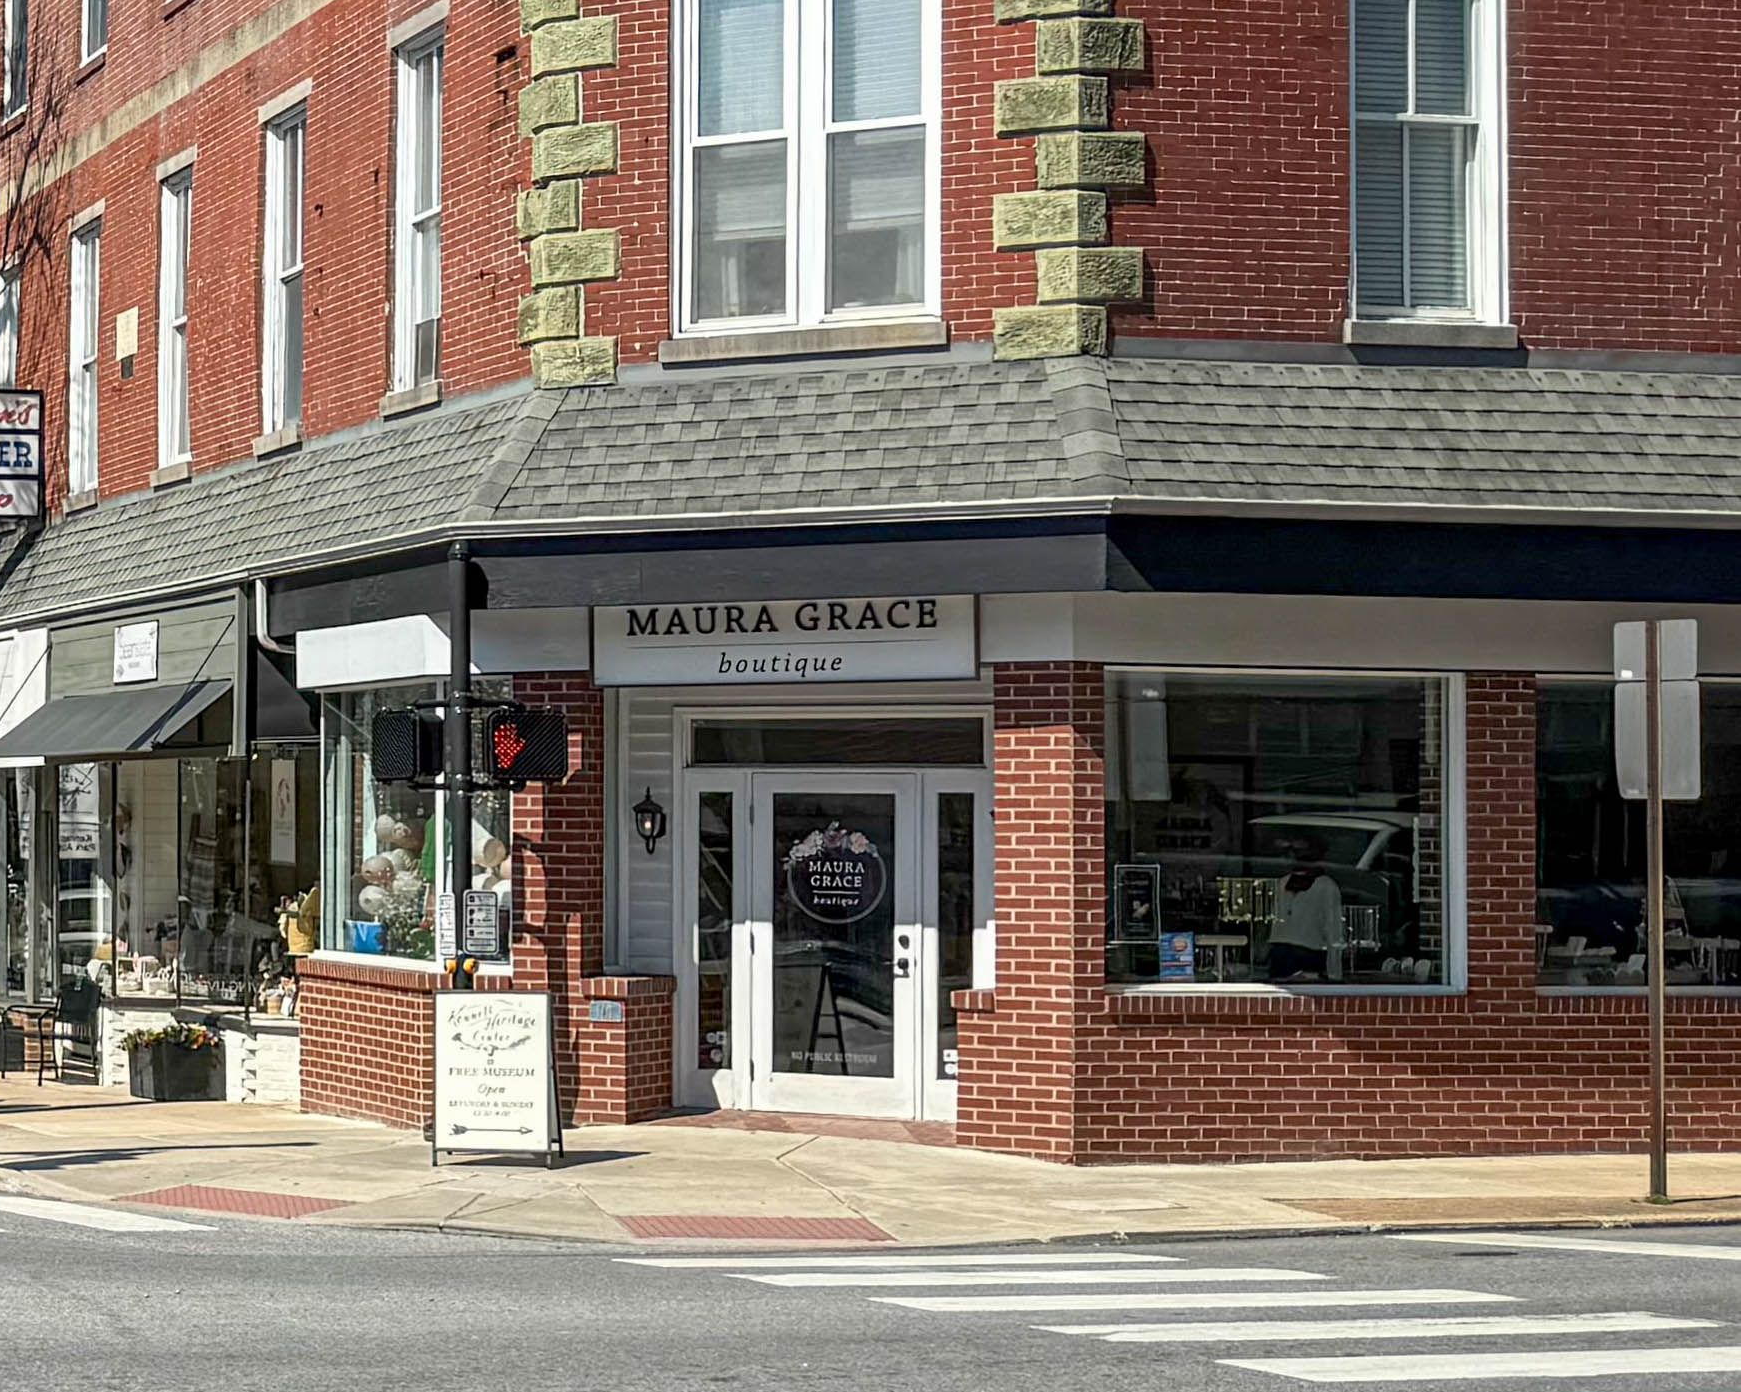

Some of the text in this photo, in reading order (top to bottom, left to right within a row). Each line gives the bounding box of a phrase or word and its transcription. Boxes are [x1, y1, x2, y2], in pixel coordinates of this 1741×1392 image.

[626, 600, 938, 636] MAURA GRACE
[718, 653, 842, 678] boutique
[809, 861, 865, 874] MAURA
[810, 875, 862, 888] GRACE
[483, 1067, 535, 1077] MUSEUM
[478, 1083, 506, 1096] Open
